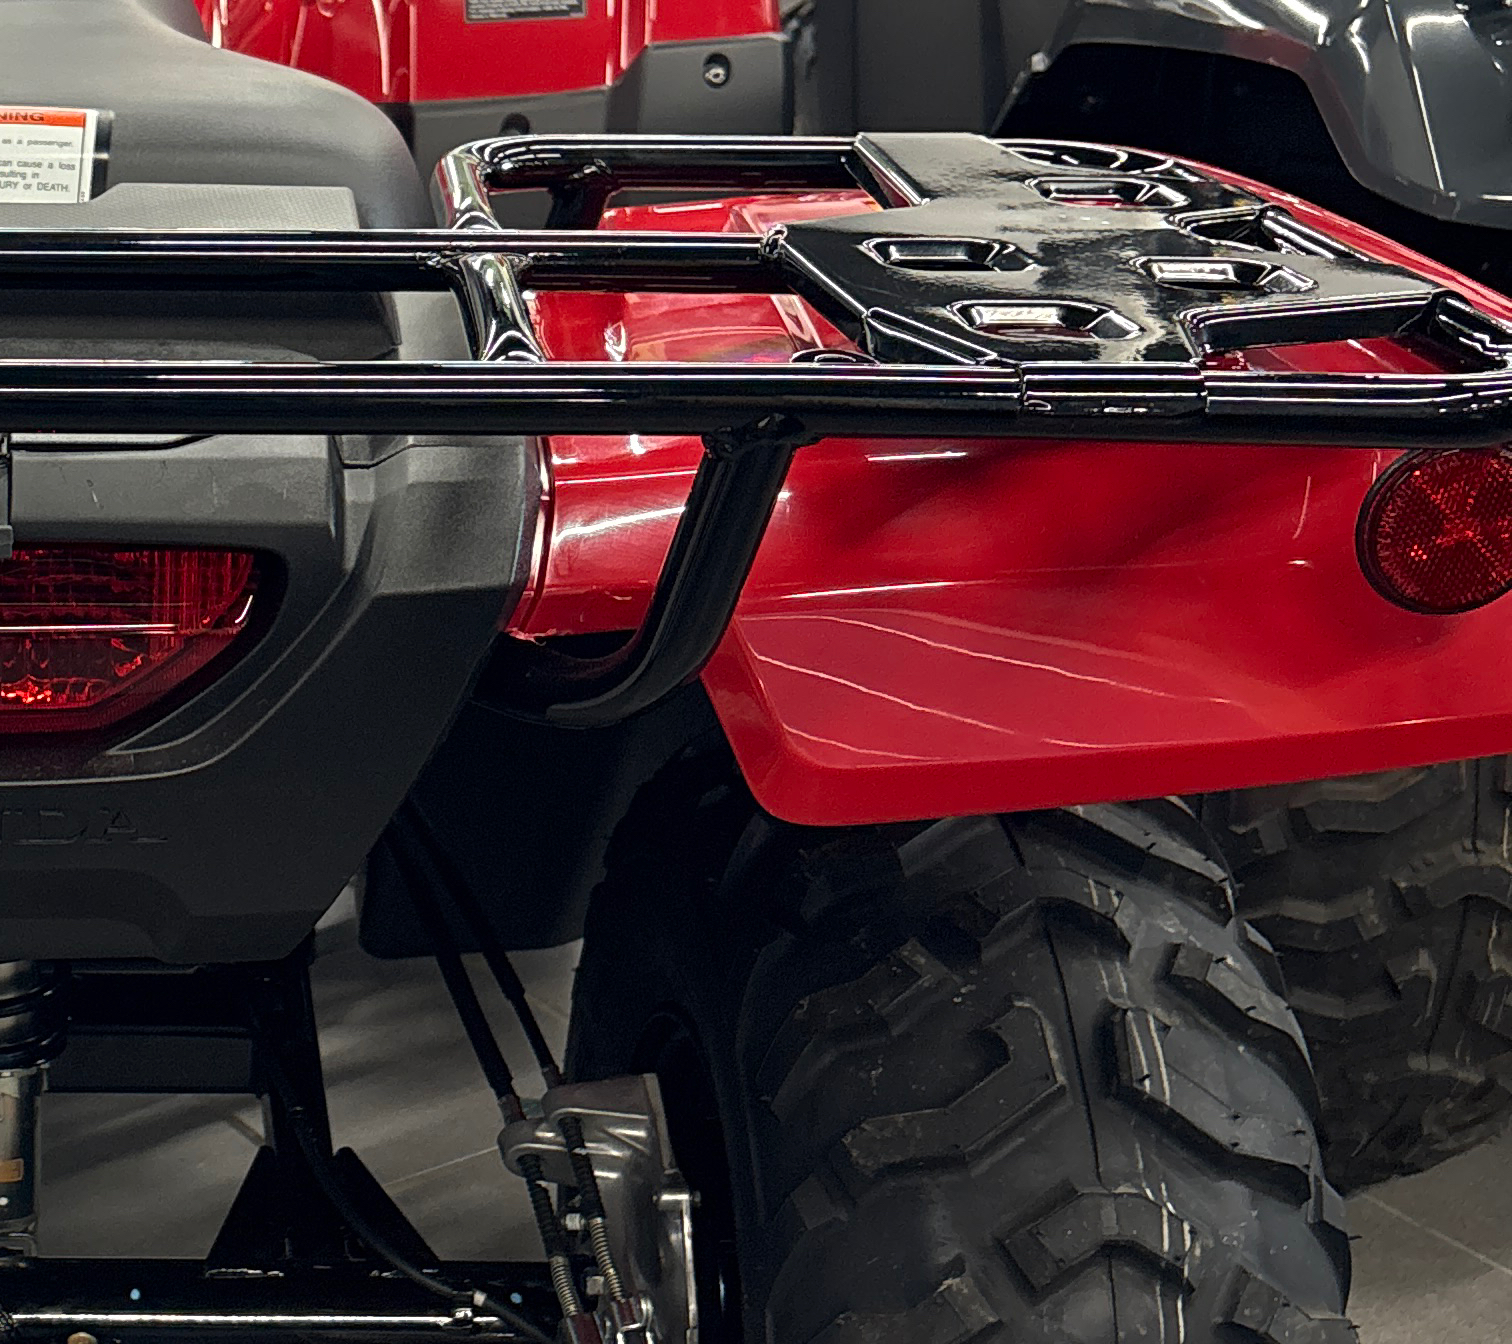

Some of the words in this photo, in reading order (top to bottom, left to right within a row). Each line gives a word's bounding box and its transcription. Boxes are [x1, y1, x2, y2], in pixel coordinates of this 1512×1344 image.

[17, 160, 42, 169] cause
[59, 161, 76, 171] loss
[31, 171, 39, 179] in
[23, 183, 33, 191] or
[36, 181, 71, 193] DEATH.
